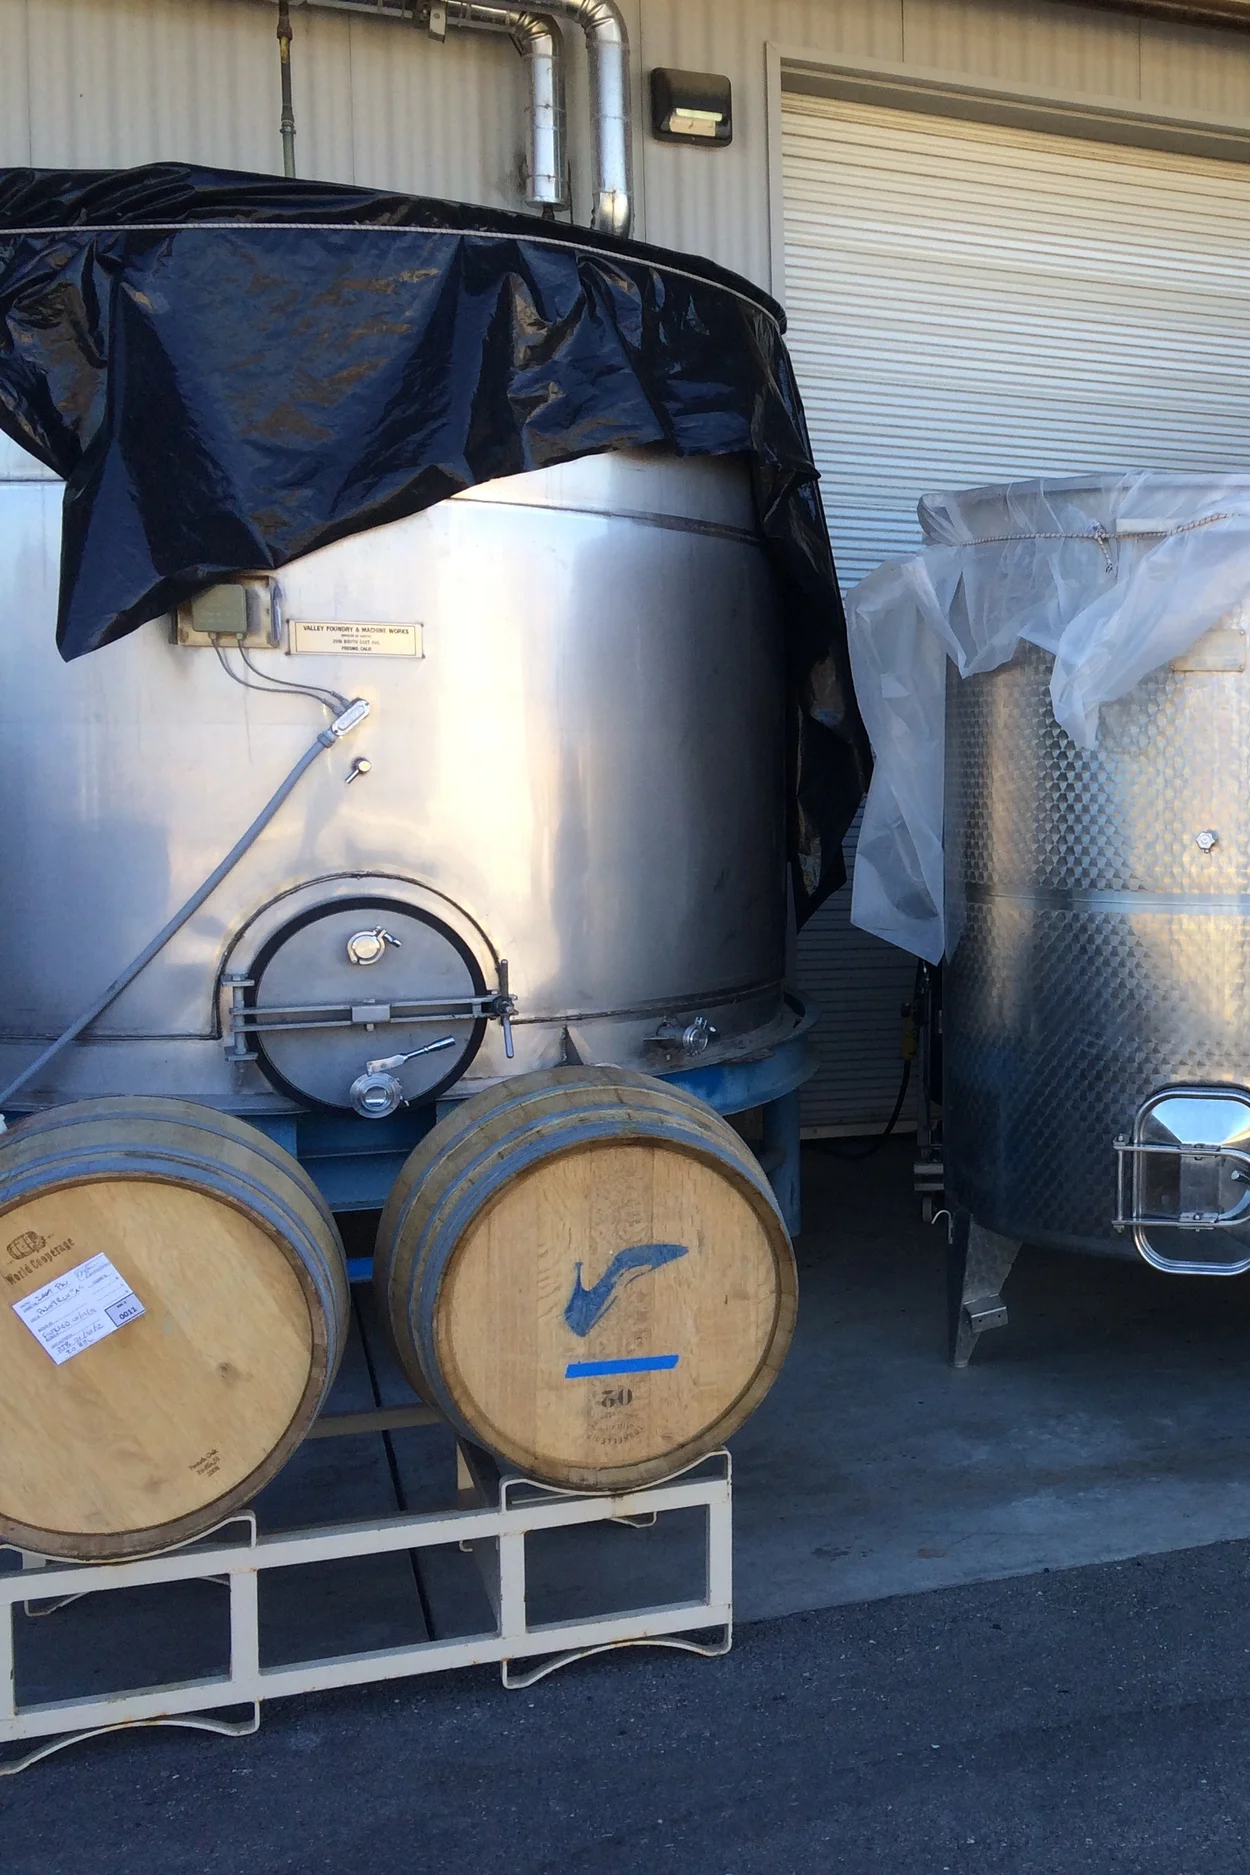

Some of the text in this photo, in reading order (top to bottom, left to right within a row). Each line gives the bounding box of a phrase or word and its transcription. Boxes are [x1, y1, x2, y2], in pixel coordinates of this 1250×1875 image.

[5, 1263, 33, 1285] World
[30, 1238, 75, 1269] Cooperage
[119, 1307, 138, 1320] 0011
